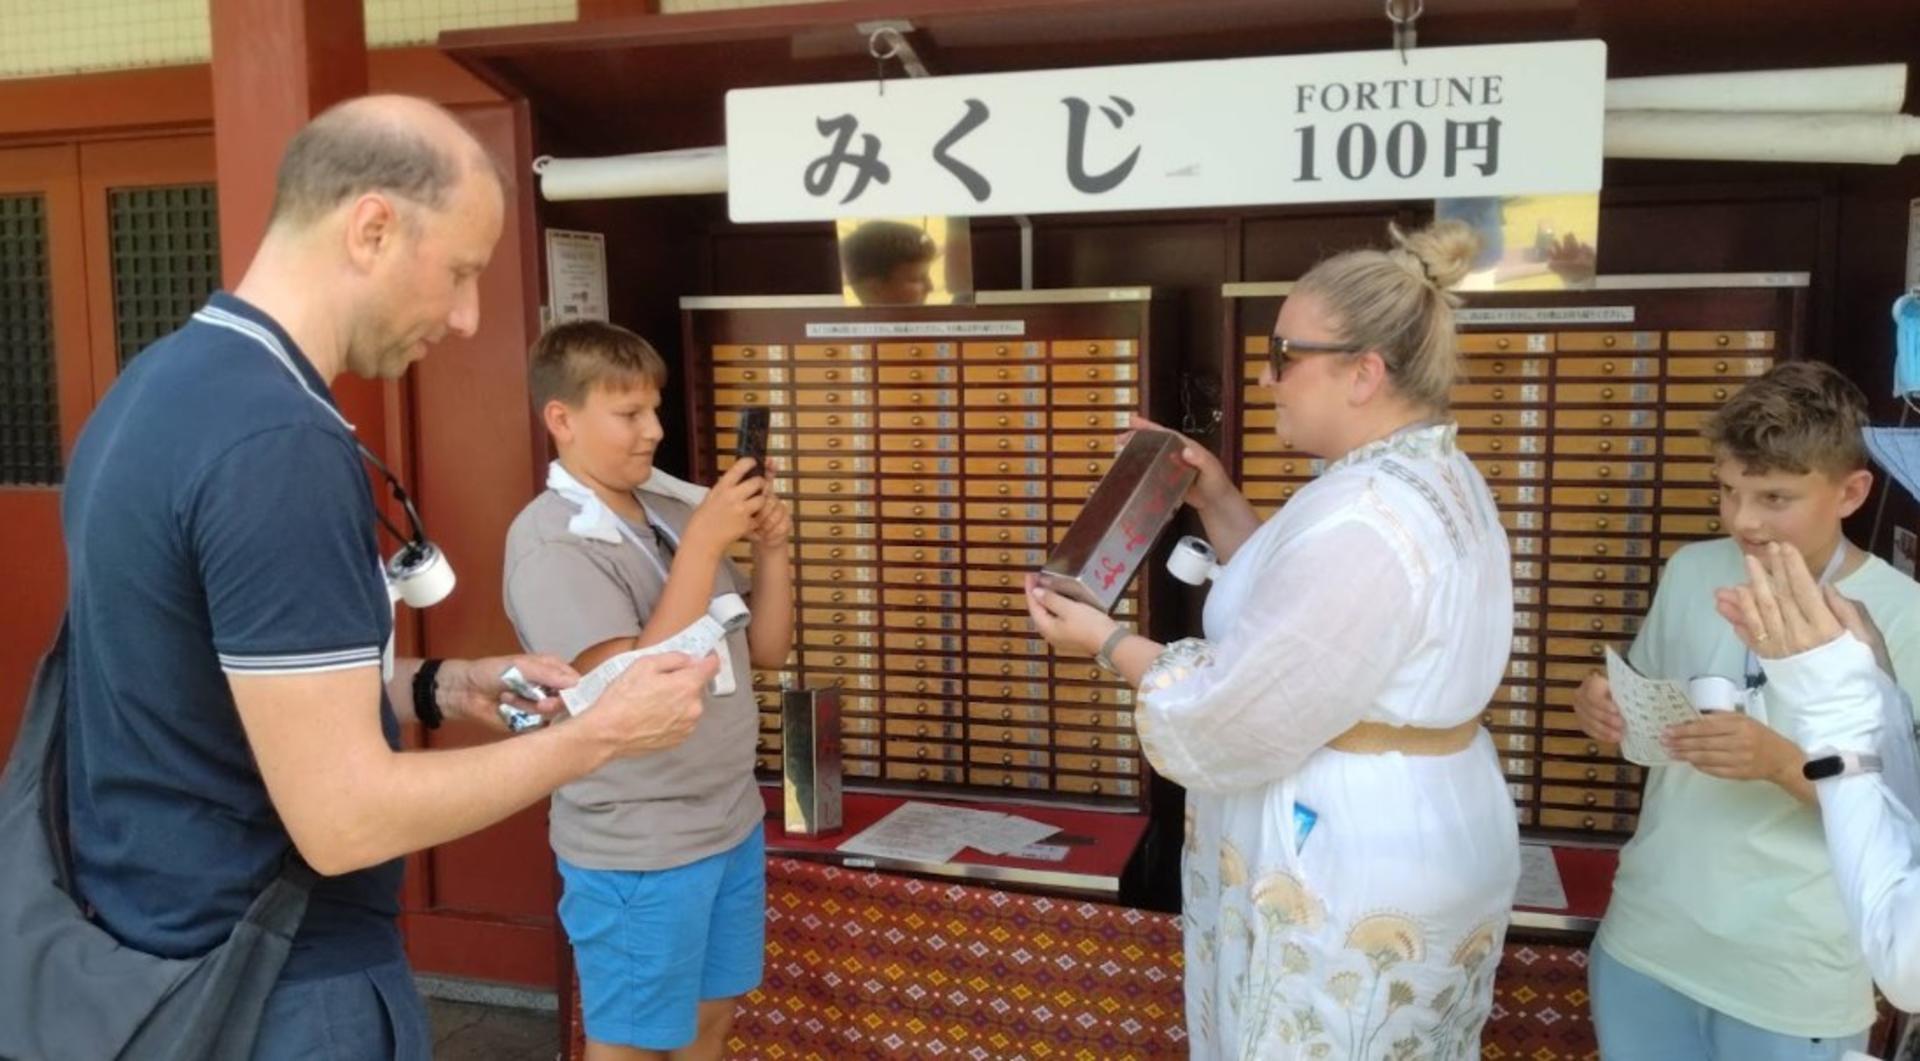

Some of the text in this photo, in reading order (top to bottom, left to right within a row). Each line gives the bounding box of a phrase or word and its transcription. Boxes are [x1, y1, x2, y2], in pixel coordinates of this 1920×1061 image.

[1296, 75, 1503, 114] FORTUNE
[804, 96, 1141, 204] みくじ
[1294, 116, 1503, 182] 100円
